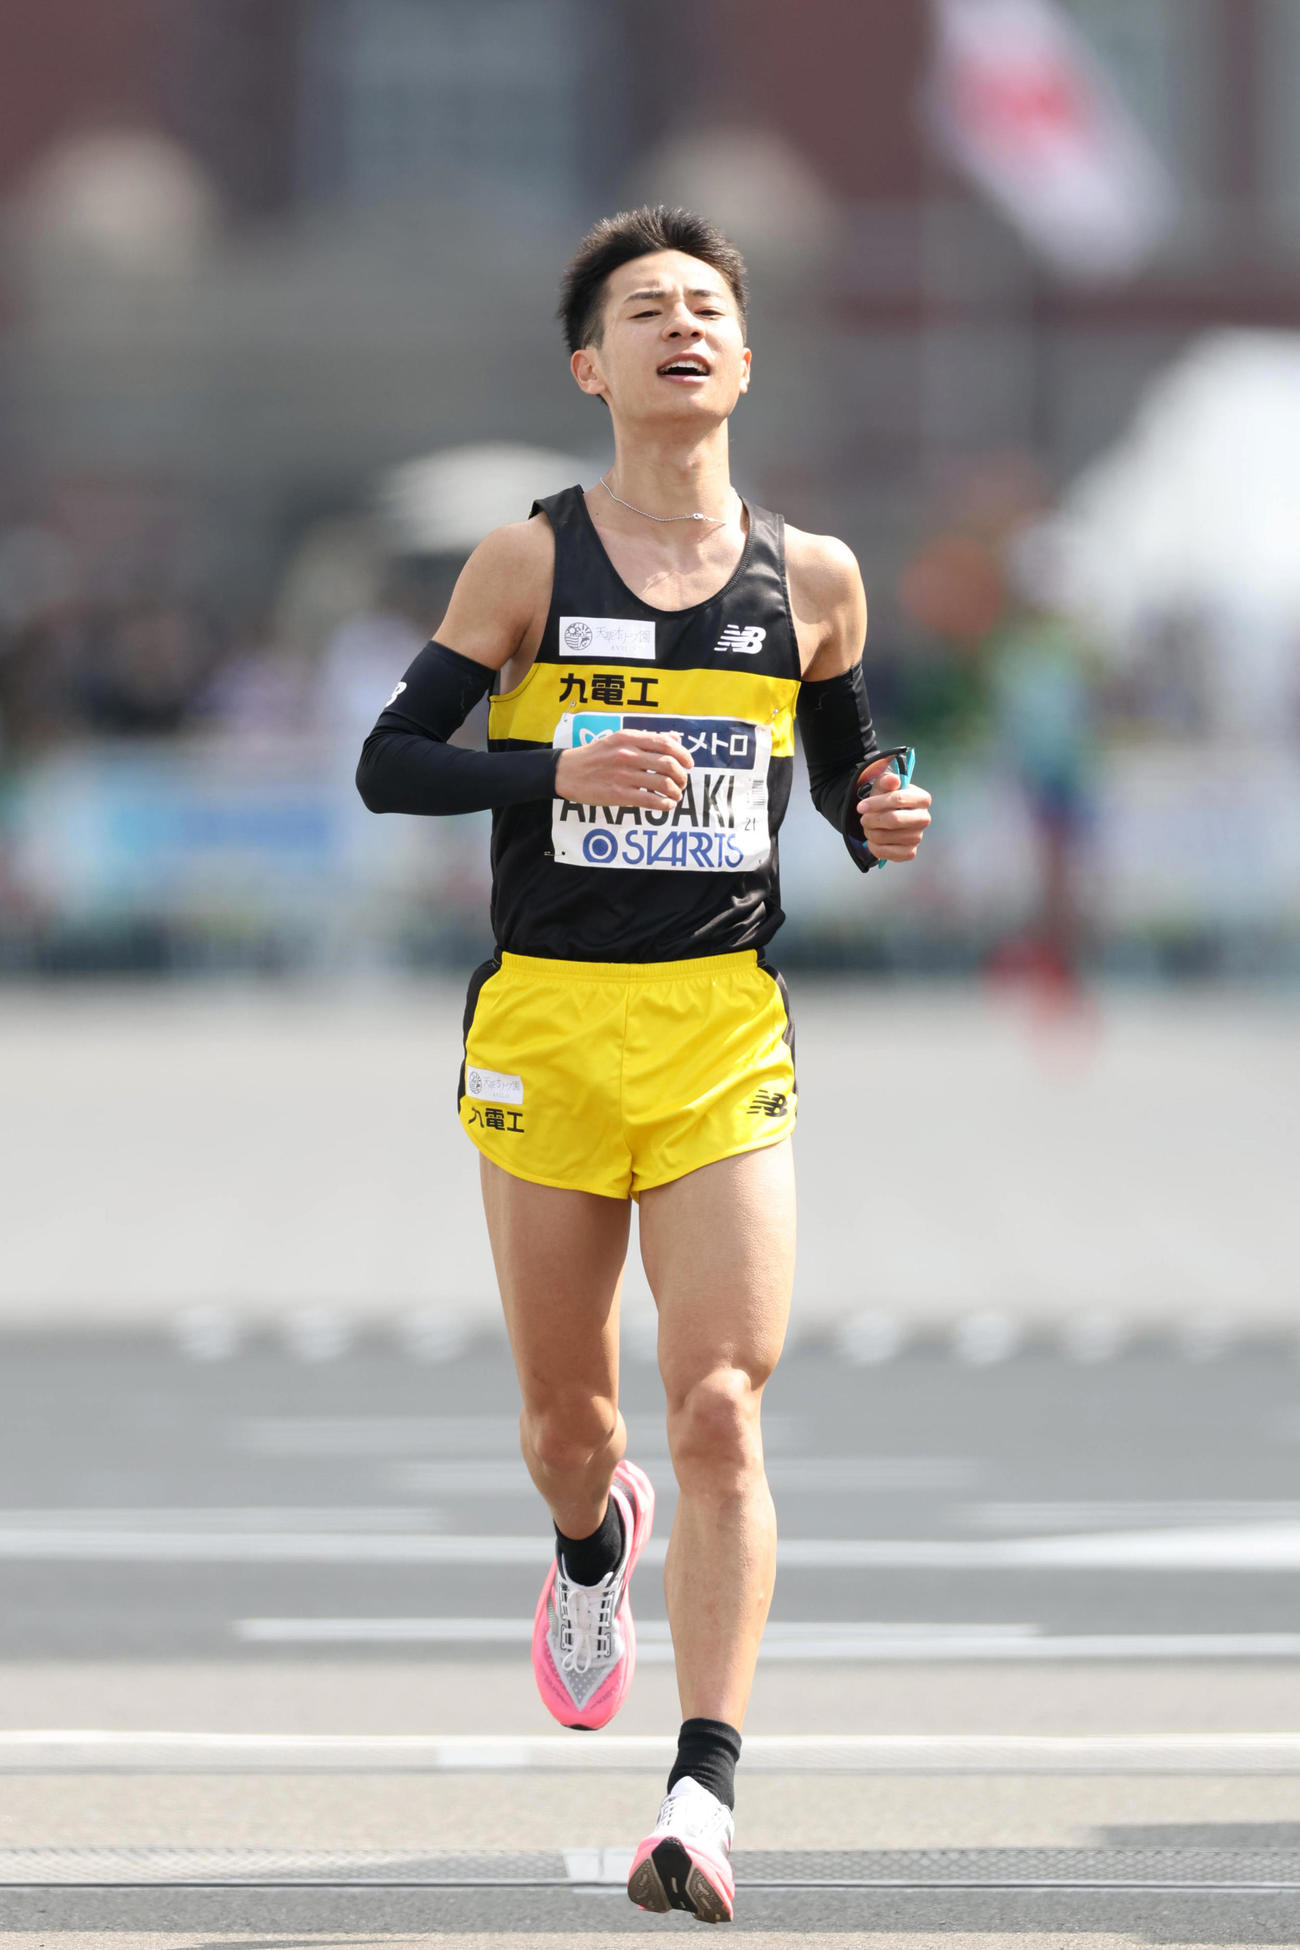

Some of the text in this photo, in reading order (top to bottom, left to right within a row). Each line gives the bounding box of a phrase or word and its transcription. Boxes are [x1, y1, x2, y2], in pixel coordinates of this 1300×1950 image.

[559, 673, 659, 707] 九電工
[642, 730, 748, 756] メトロ
[622, 829, 744, 868] STARTS
